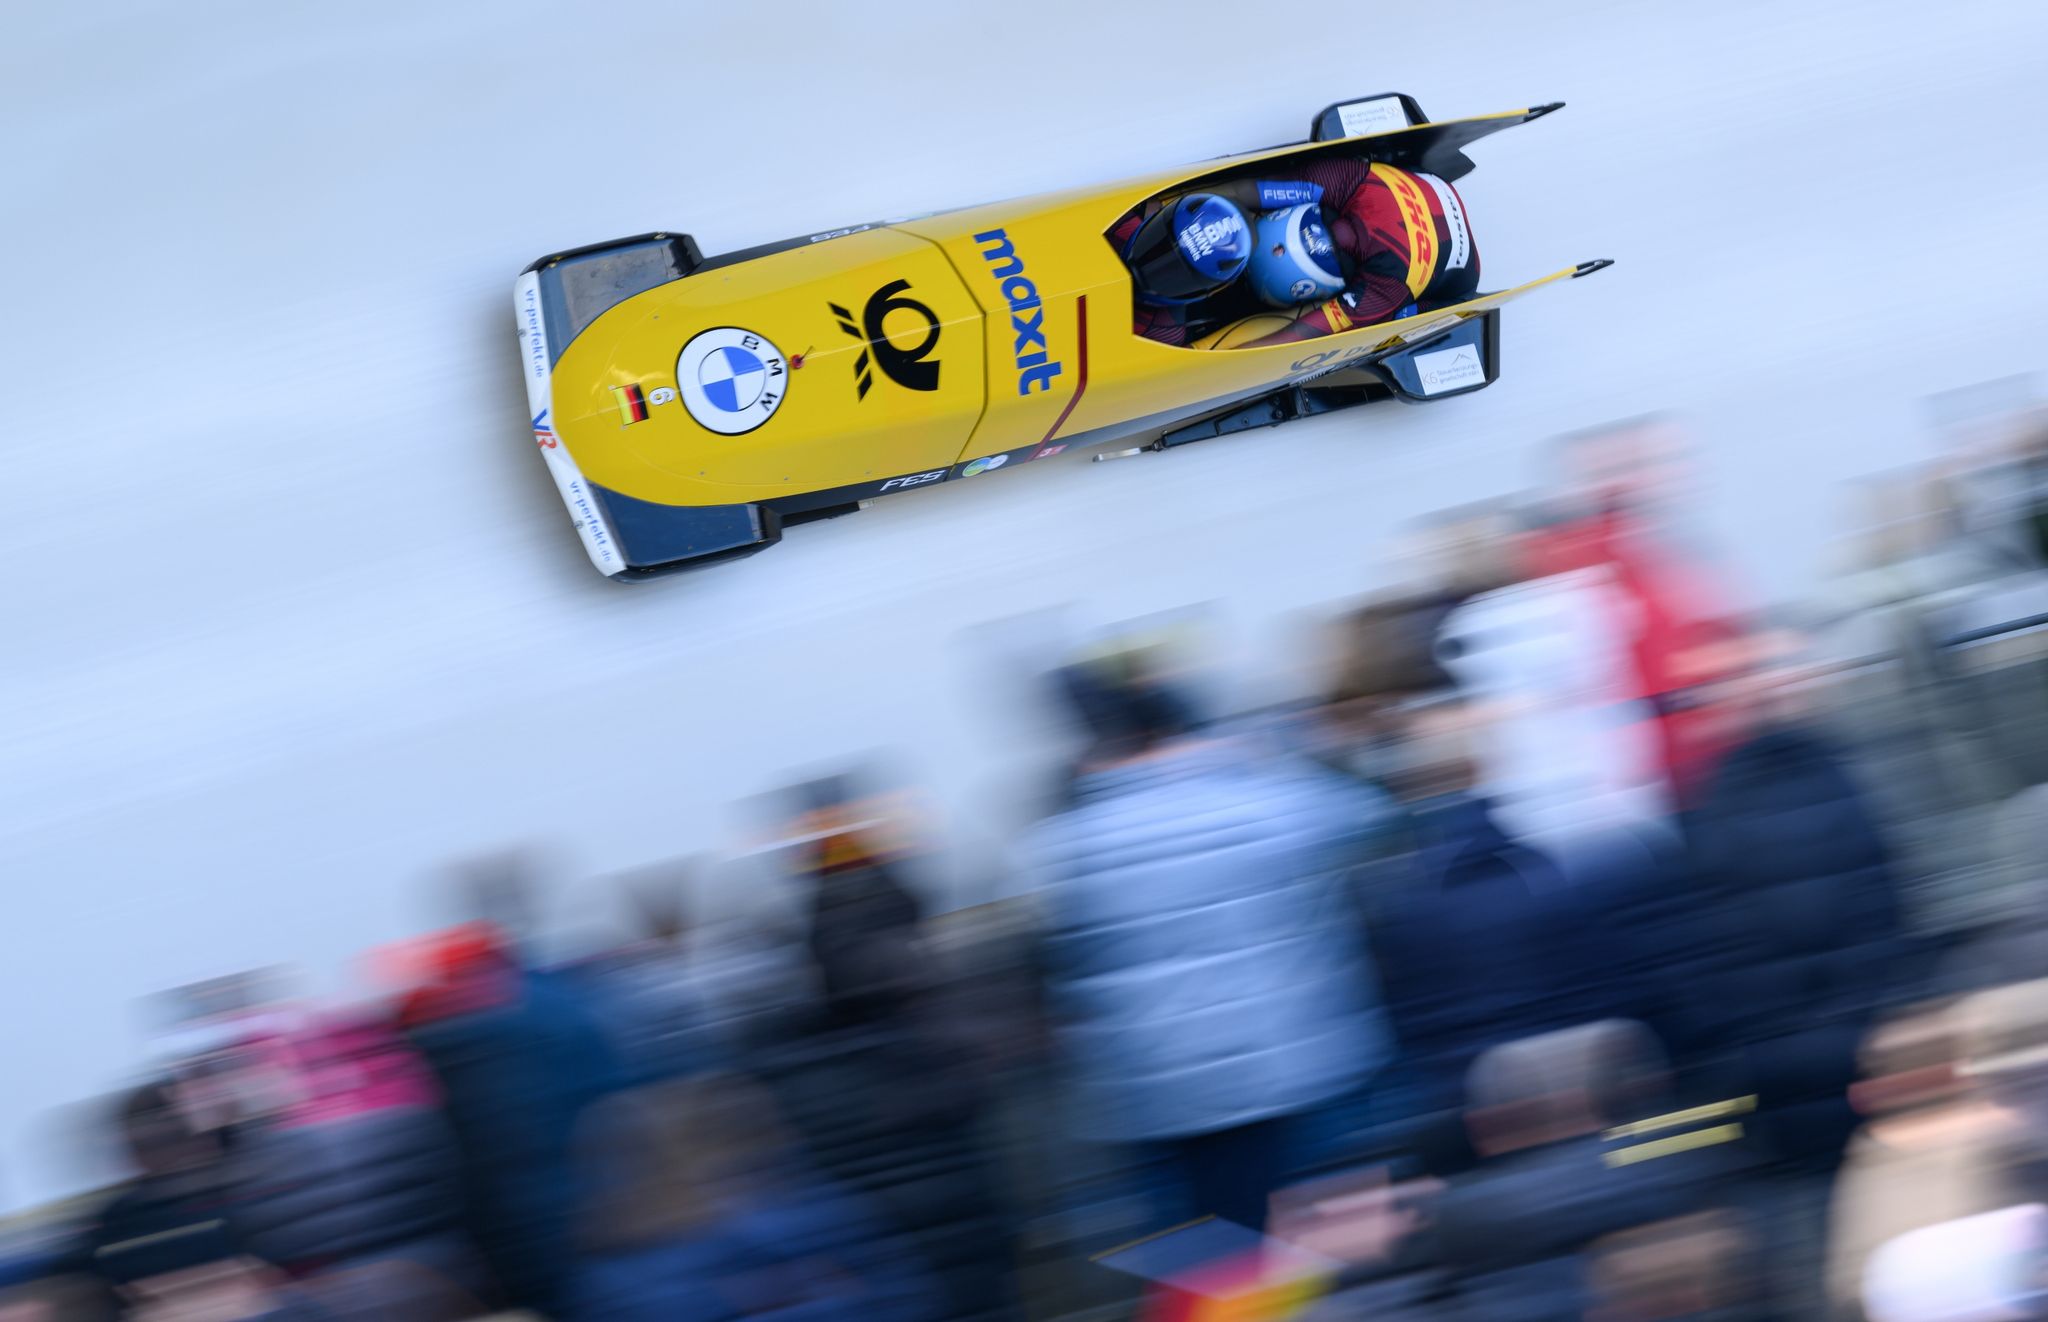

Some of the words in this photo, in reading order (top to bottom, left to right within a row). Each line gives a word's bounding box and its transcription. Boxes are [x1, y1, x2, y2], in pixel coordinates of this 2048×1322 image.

[1188, 222, 1215, 256] BMW
[1394, 178, 1432, 266] DHL
[525, 289, 545, 378] vr-perfekt.de
[972, 228, 1062, 396] maxit
[648, 386, 677, 407] 6
[741, 335, 787, 412] BMW
[532, 408, 558, 449] VR
[879, 469, 947, 492] FES
[569, 481, 612, 562] vr-perfekt.de
